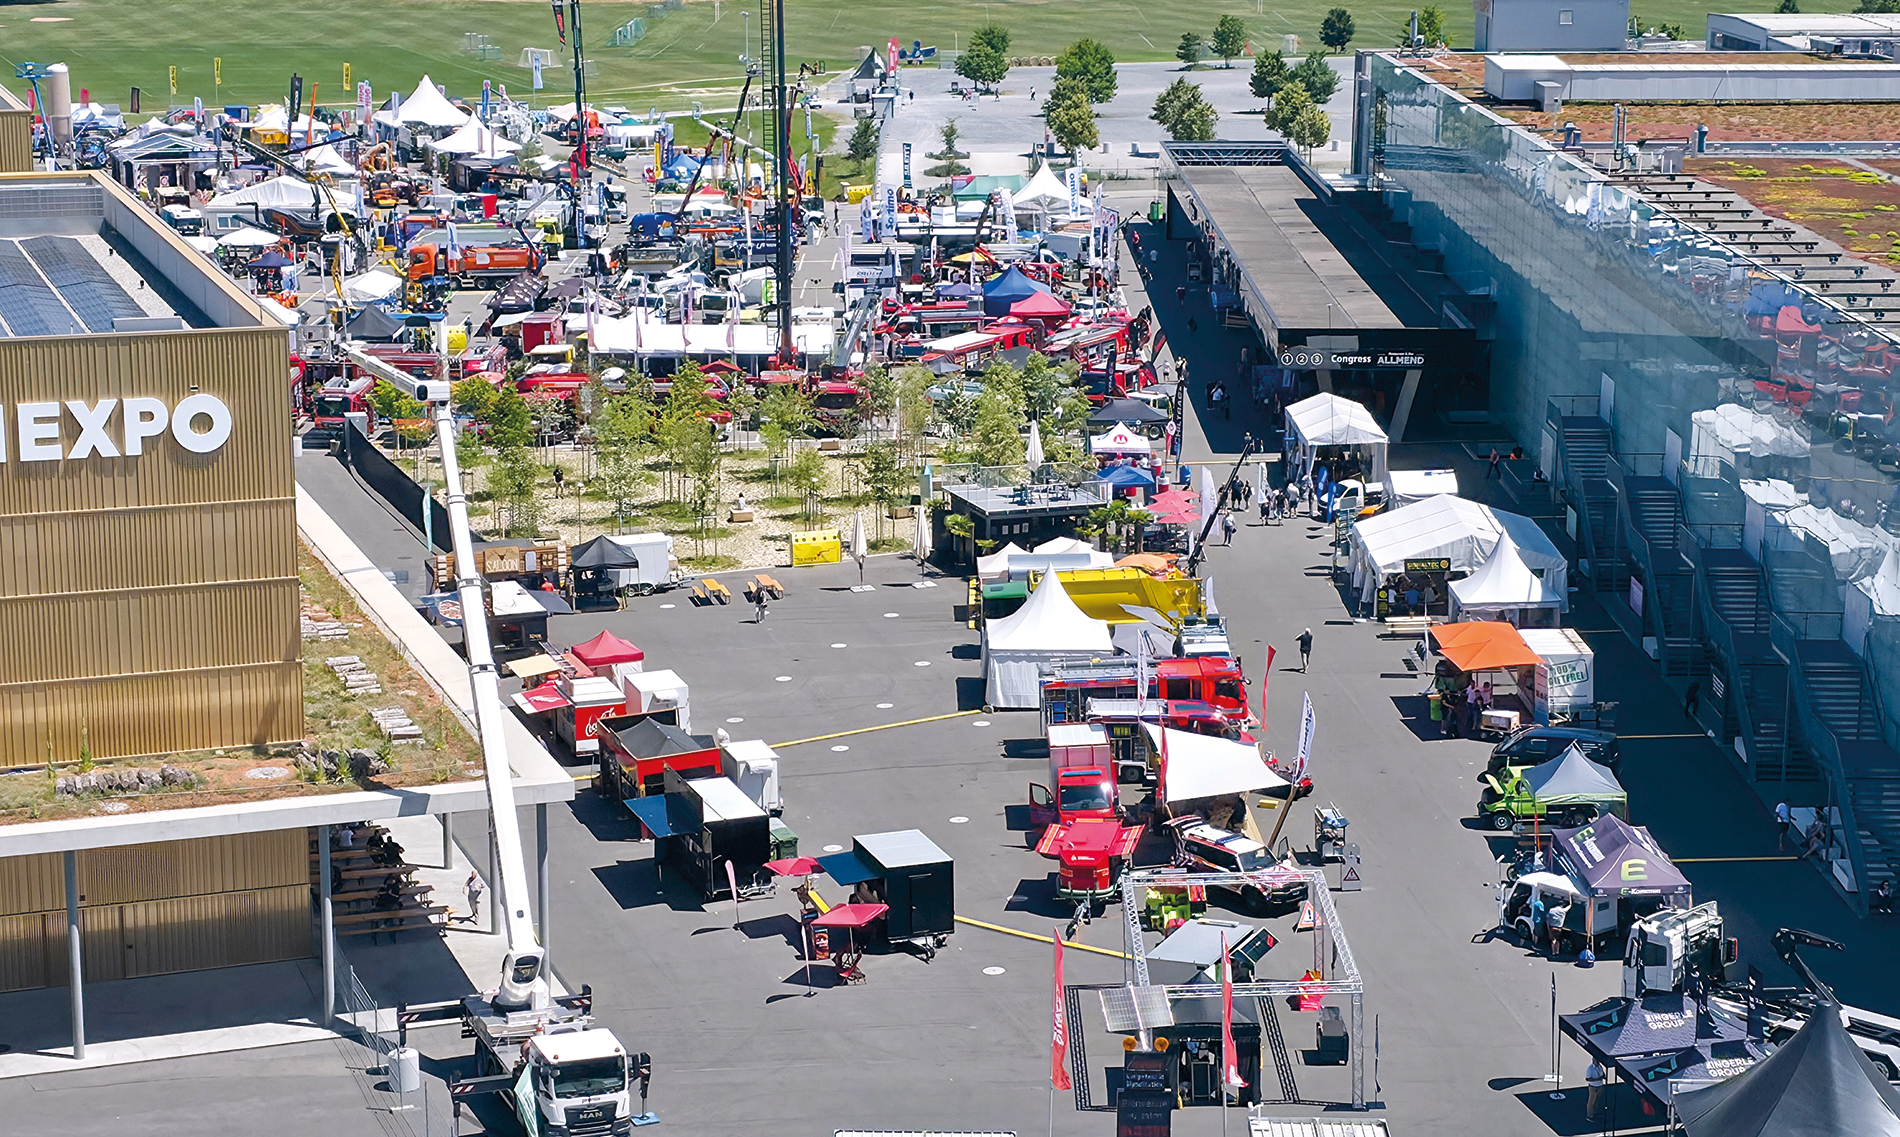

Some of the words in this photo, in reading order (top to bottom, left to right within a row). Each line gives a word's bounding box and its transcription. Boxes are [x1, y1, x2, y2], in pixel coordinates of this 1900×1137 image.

[1331, 354, 1372, 365] Congress
[1377, 356, 1424, 364] ALLMEND
[0, 393, 233, 463] EXPO
[486, 559, 518, 572] SALOON
[1649, 1019, 1685, 1030] GROUP
[1709, 1066, 1746, 1077] GROUP
[579, 1111, 603, 1120] MAN
